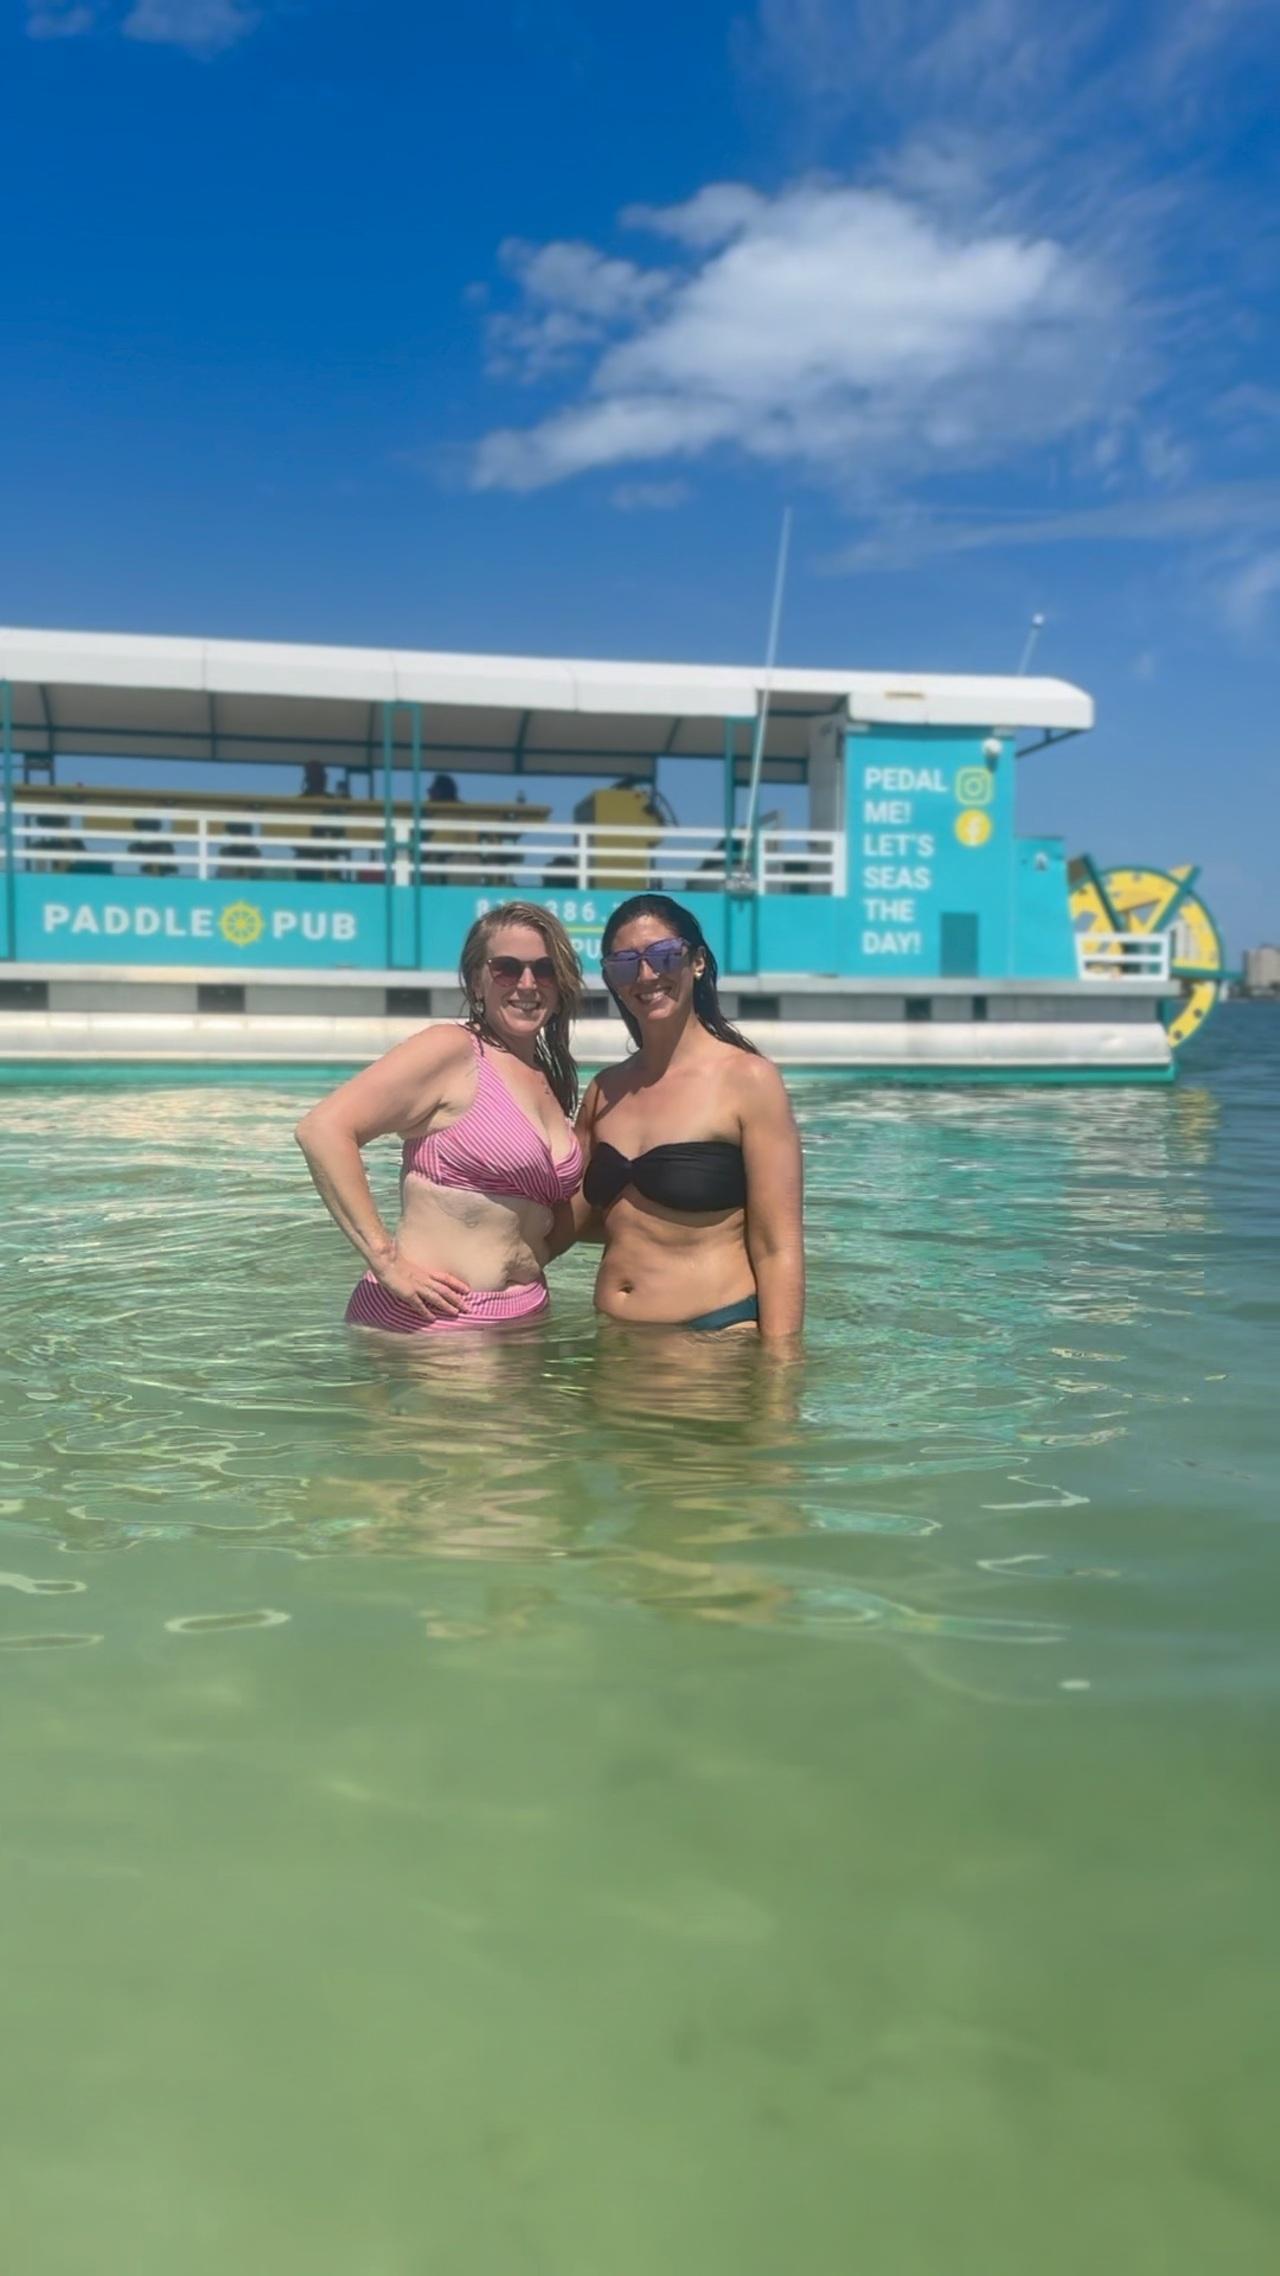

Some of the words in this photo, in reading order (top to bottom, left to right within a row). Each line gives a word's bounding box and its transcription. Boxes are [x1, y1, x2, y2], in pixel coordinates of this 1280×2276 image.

[864, 767, 948, 792] PEDAL
[864, 801, 912, 825] ME!
[863, 833, 934, 857] LET'S
[863, 866, 931, 890] SEAS
[43, 904, 214, 937] PADDLE
[273, 911, 357, 940] PUB
[864, 899, 915, 922] THE
[862, 931, 920, 955] DAY!
